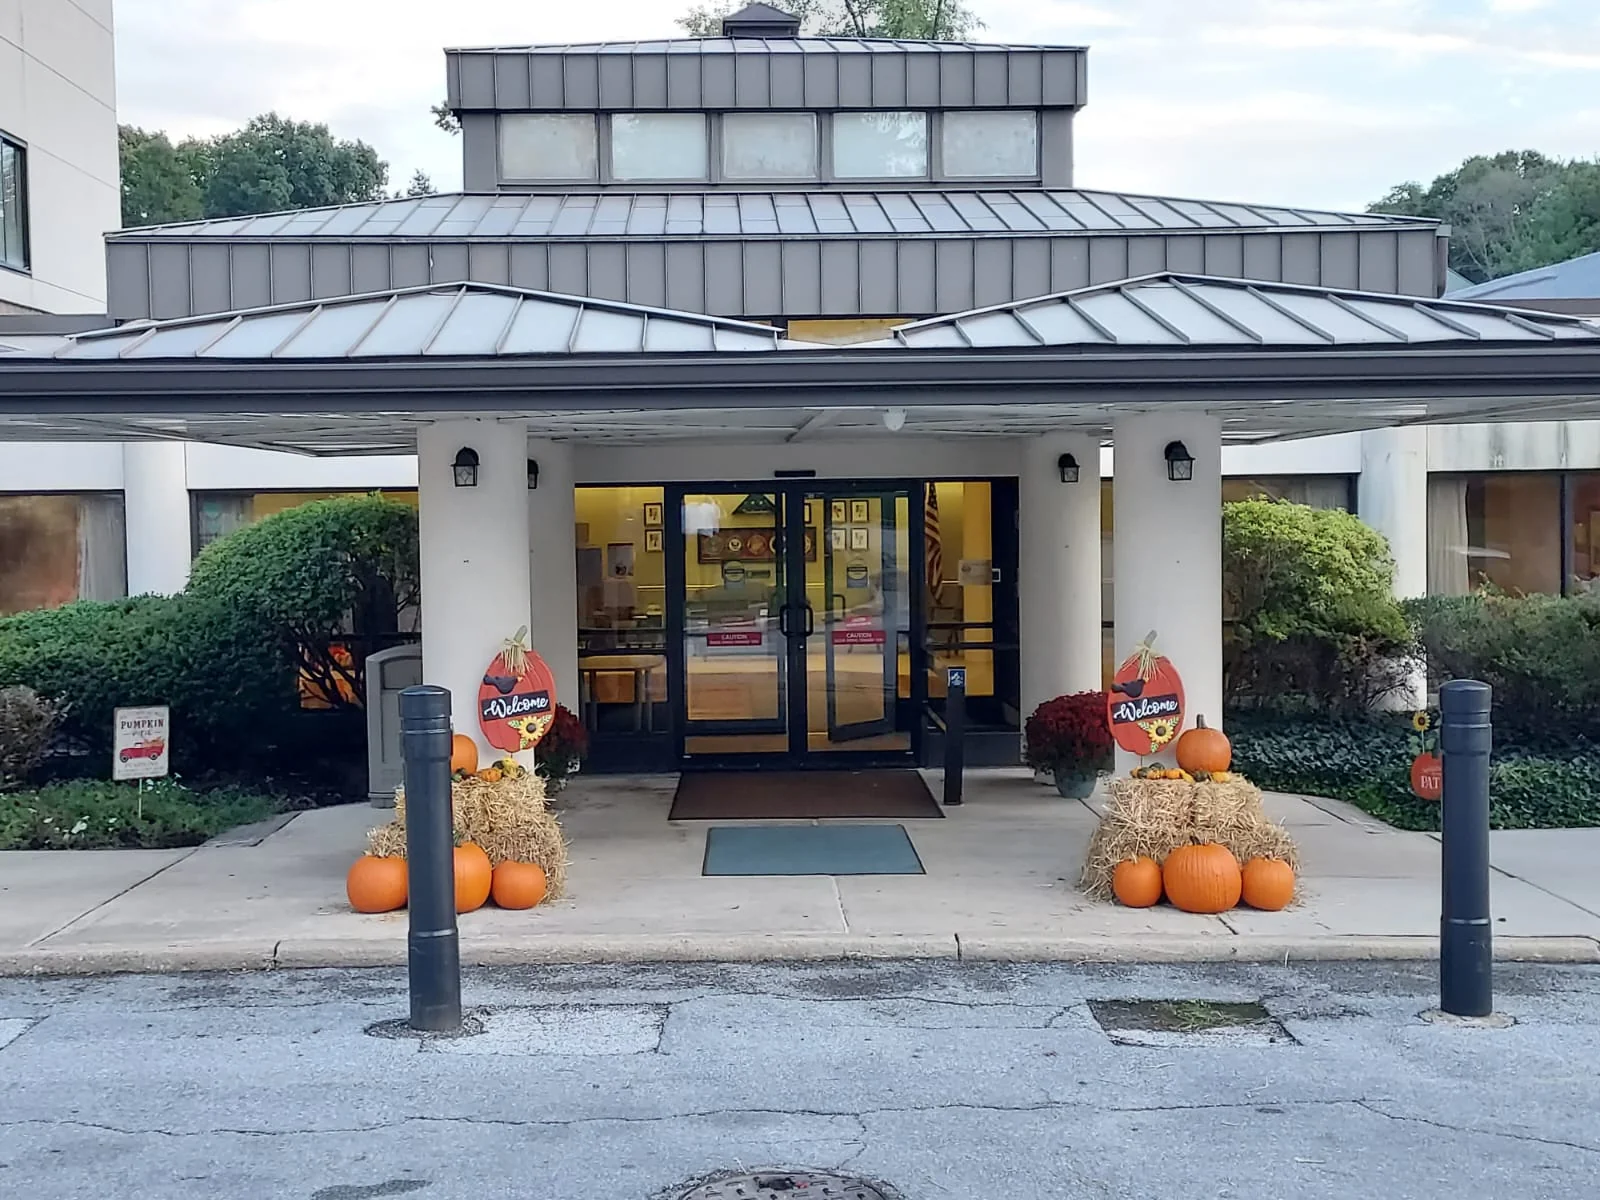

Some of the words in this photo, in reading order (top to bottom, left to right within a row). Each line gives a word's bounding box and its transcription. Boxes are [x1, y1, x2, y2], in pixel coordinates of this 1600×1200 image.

[484, 695, 548, 718] Welcome
[1114, 699, 1177, 721] Welcome
[121, 719, 164, 730] PUMPKIN
[1420, 775, 1441, 790] PAT
